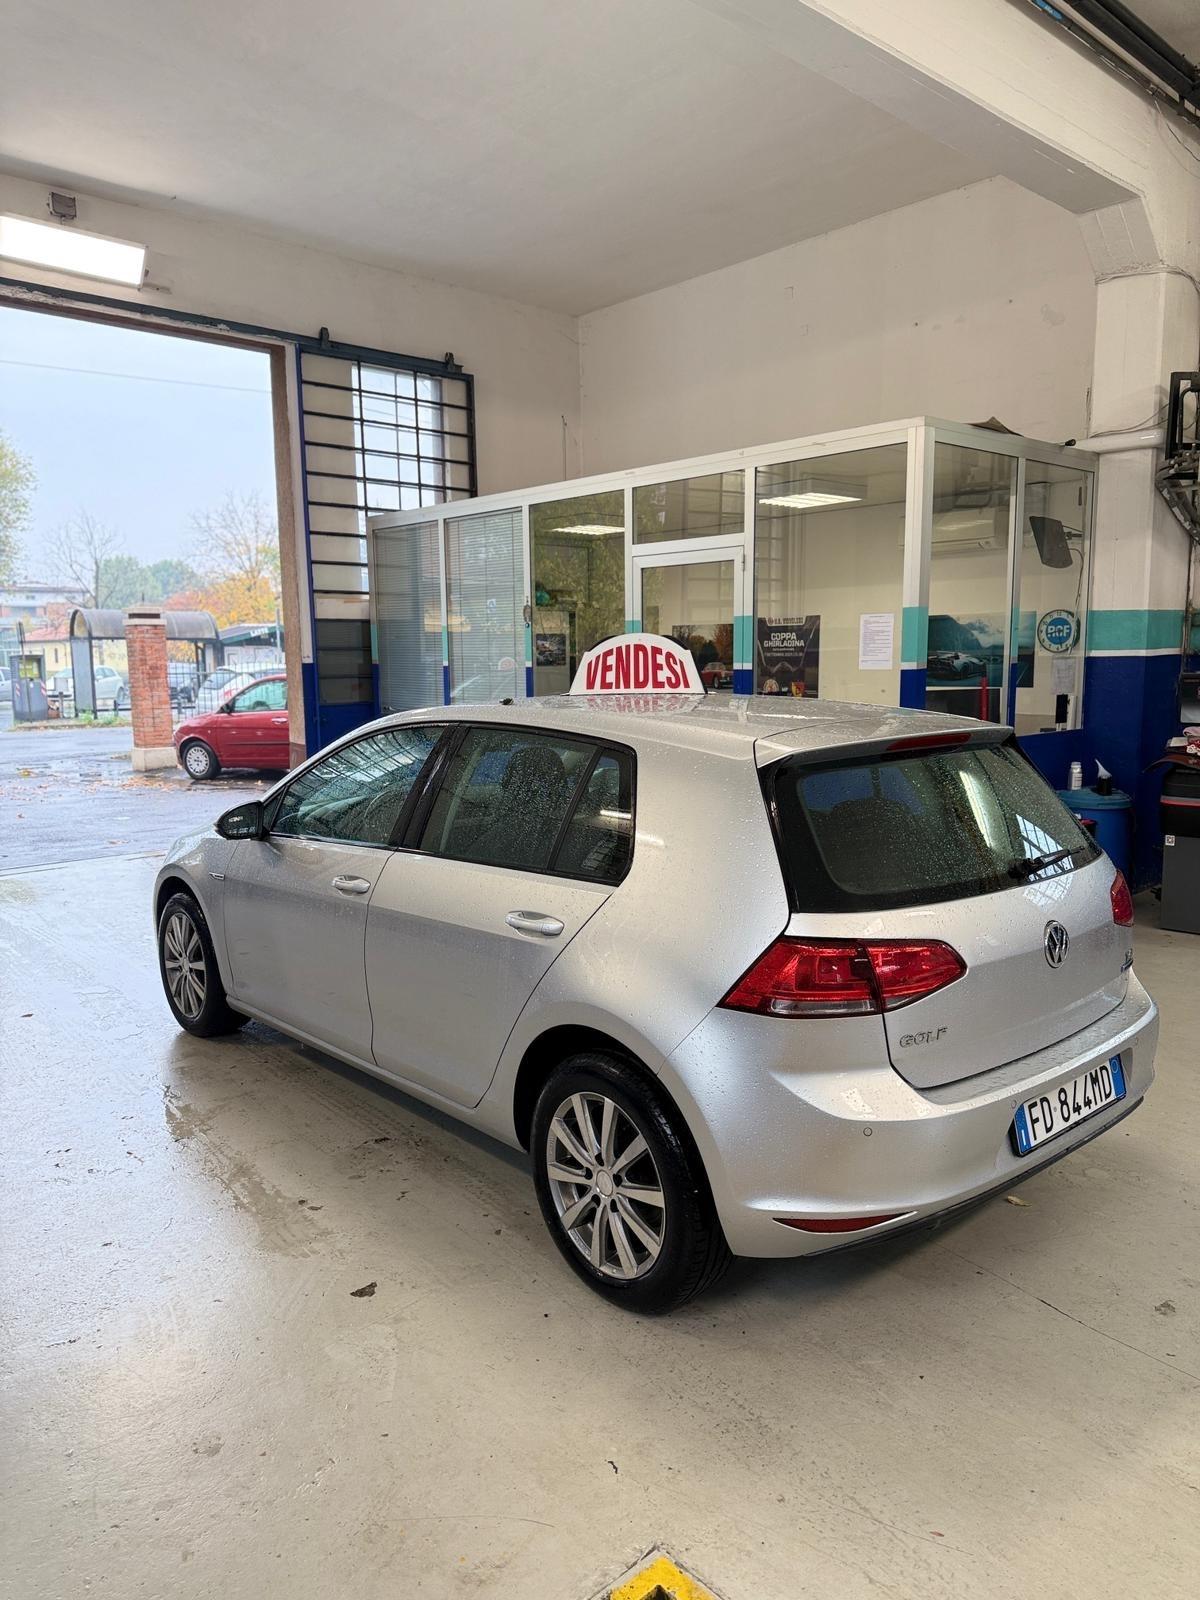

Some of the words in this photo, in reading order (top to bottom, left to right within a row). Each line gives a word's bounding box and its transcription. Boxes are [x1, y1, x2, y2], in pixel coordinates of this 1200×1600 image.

[771, 632, 797, 641] COPPA
[586, 644, 690, 690] VENDESI
[899, 1027, 948, 1048] GOLF
[1027, 1096, 1054, 1141] FD
[1058, 1065, 1112, 1122] 844MD
